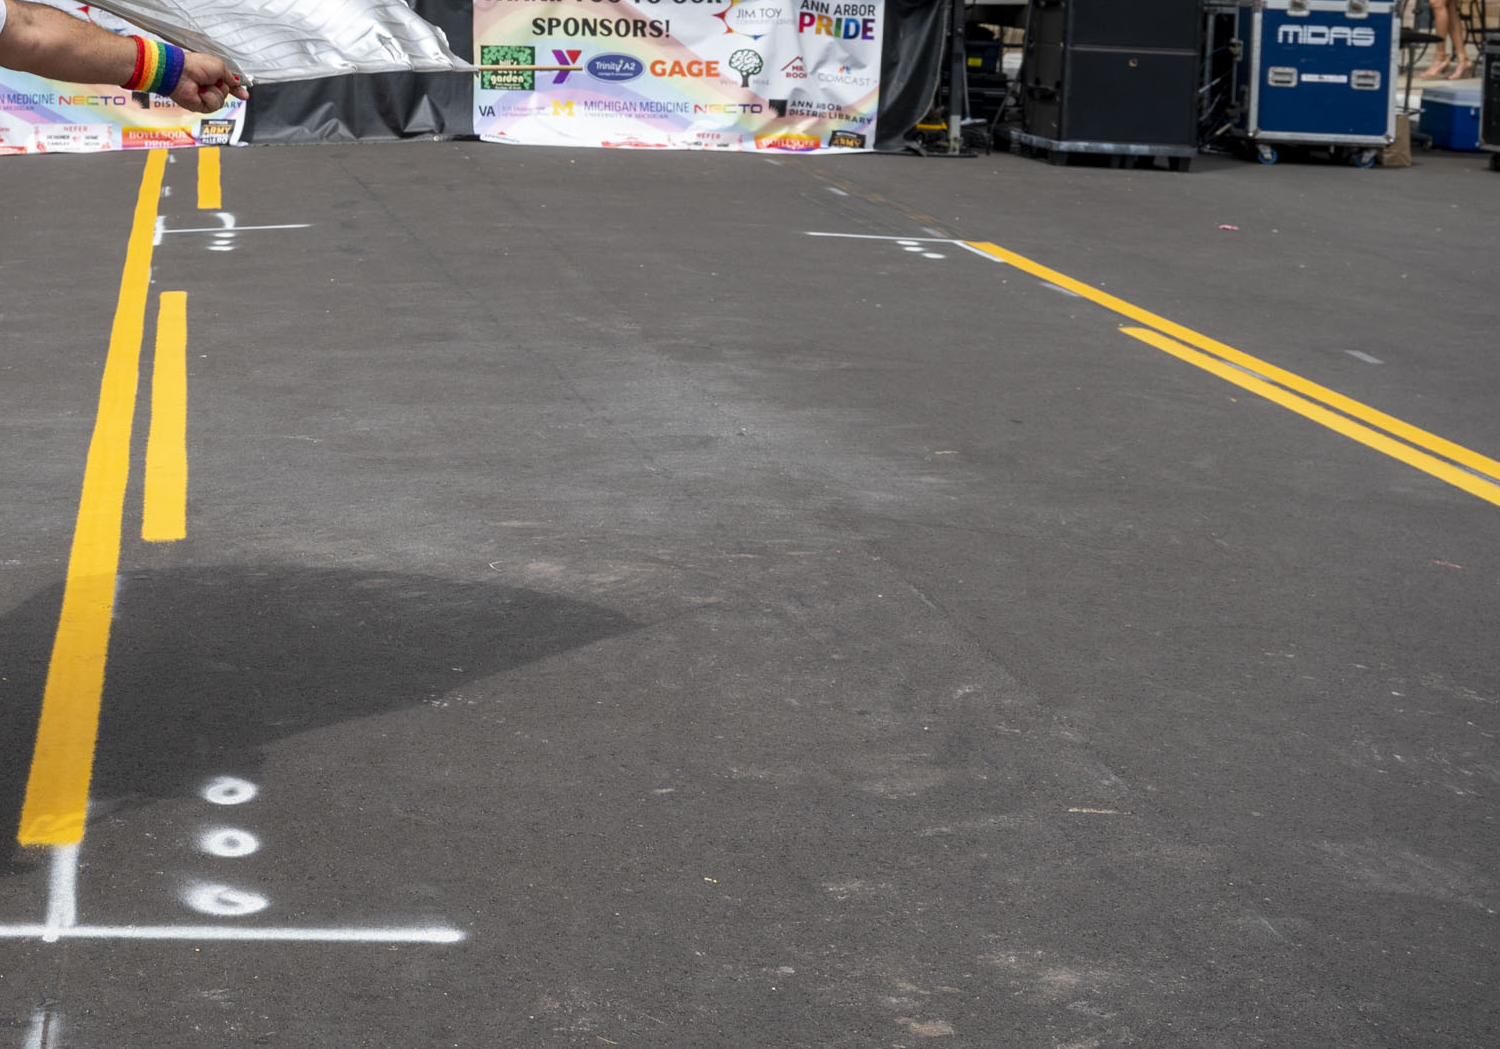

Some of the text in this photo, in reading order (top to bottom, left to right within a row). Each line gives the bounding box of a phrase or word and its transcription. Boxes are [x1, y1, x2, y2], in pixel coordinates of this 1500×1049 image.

[735, 7, 783, 19] JIM TOY
[833, 3, 876, 17] ARBOR
[531, 16, 672, 39] SPONSORS!
[798, 11, 876, 41] PRIDE
[1276, 23, 1376, 47] MIDAS
[595, 60, 636, 72] Trinity A2
[650, 59, 721, 78] GAGE
[490, 72, 524, 85] garden
[818, 72, 871, 87] COMCAST
[7, 93, 55, 105] MEDICINE
[58, 95, 127, 106] NECTO
[790, 99, 814, 109] ANN
[478, 104, 496, 117] VA
[551, 100, 576, 117] M
[583, 100, 690, 114] MICHIGAN MEDICINE
[693, 103, 763, 115] NECTO
[828, 112, 874, 125] LIBRARY
[203, 125, 232, 134] ARMY
[832, 137, 861, 148] ARMY
